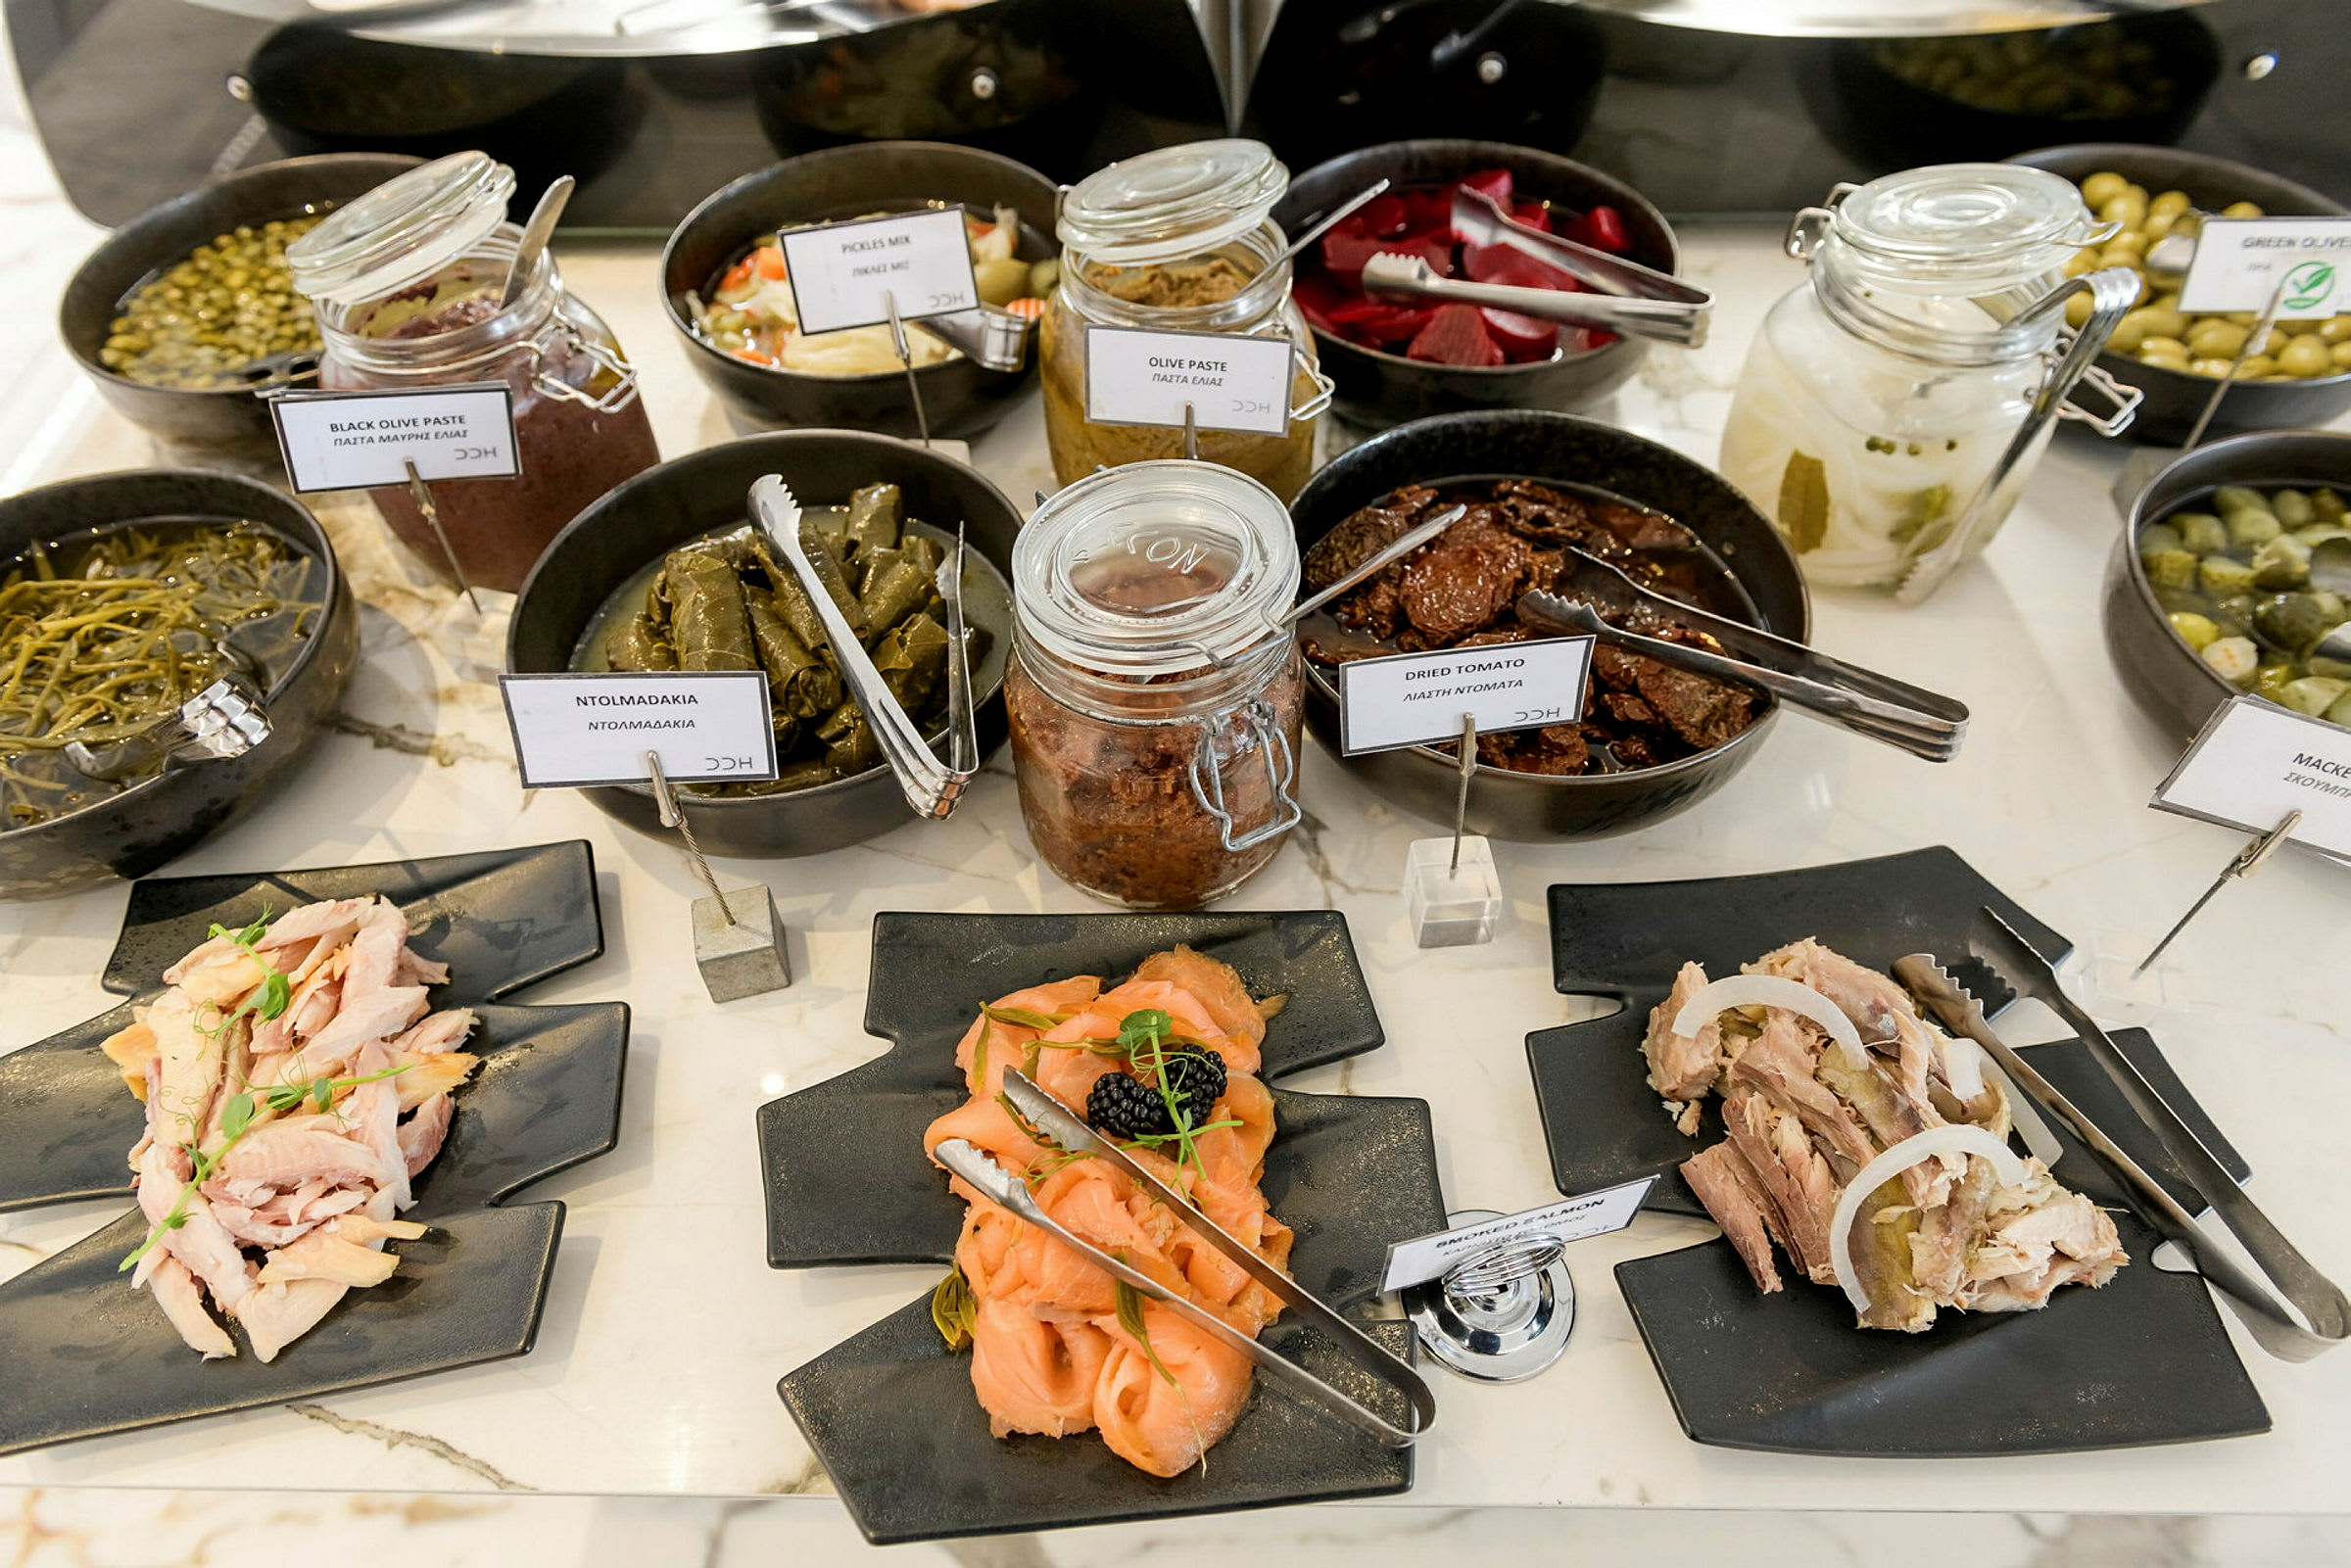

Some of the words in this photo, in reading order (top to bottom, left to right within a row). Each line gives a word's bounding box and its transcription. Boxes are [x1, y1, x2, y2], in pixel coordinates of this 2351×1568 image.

[841, 238, 886, 254] PICKLES
[888, 234, 911, 247] MIX
[2241, 236, 2296, 249] GREEN
[1148, 356, 1185, 369] OLIVE
[1188, 359, 1227, 372] PASTE
[1152, 372, 1188, 385] ΠΑΣΤΑ
[1191, 375, 1224, 387] ΕΛΙΑΣ
[329, 419, 375, 433] BLACK
[379, 416, 419, 430] OLIVE
[422, 414, 466, 427] PASTE
[333, 434, 375, 447] ΠΑΣΤΑ
[378, 431, 431, 444] ΜΑΥΡΗΣ
[433, 429, 470, 440] ΕΛΙΑΣ
[1405, 667, 1452, 681] DRIED
[1456, 658, 1525, 675] TOMATO
[1403, 688, 1452, 702] ΛΙΑΣΤΗ
[1455, 679, 1523, 695] ΝΤΟΜΑΤΑ
[575, 694, 698, 707] NTOLMADAKIA
[588, 719, 696, 731] ΝΤΟΛΜΑΔΑΚΙΑ
[2292, 752, 2351, 779] MACKE
[1436, 1221, 1518, 1249] SMOKED
[1522, 1199, 1605, 1225] SALMON
